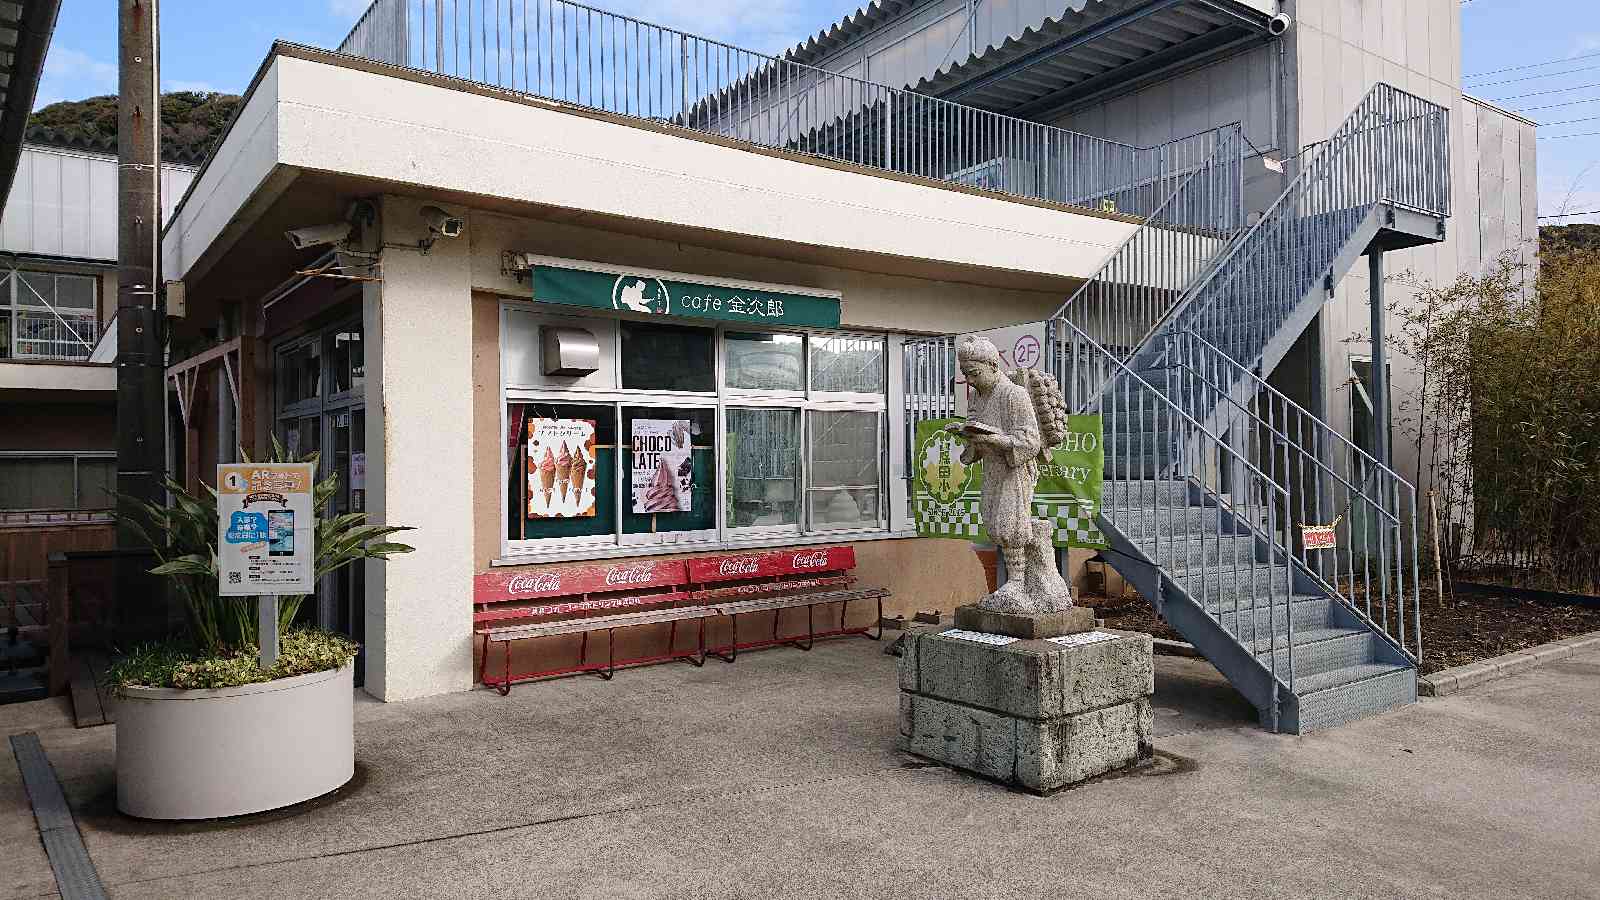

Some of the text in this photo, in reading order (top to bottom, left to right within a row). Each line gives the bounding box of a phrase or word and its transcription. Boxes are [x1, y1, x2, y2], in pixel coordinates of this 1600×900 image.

[681, 294, 721, 312] cafe
[727, 295, 784, 318] 金次郎
[1017, 343, 1036, 363] 2F
[632, 435, 672, 452] CHOCO
[632, 453, 660, 470] LATE
[229, 475, 236, 487] 1
[1039, 464, 1091, 485] ersary
[720, 551, 828, 576] Coca-Cola Coca-Cola
[508, 562, 655, 594] Coca-Cola Coca-Cola
